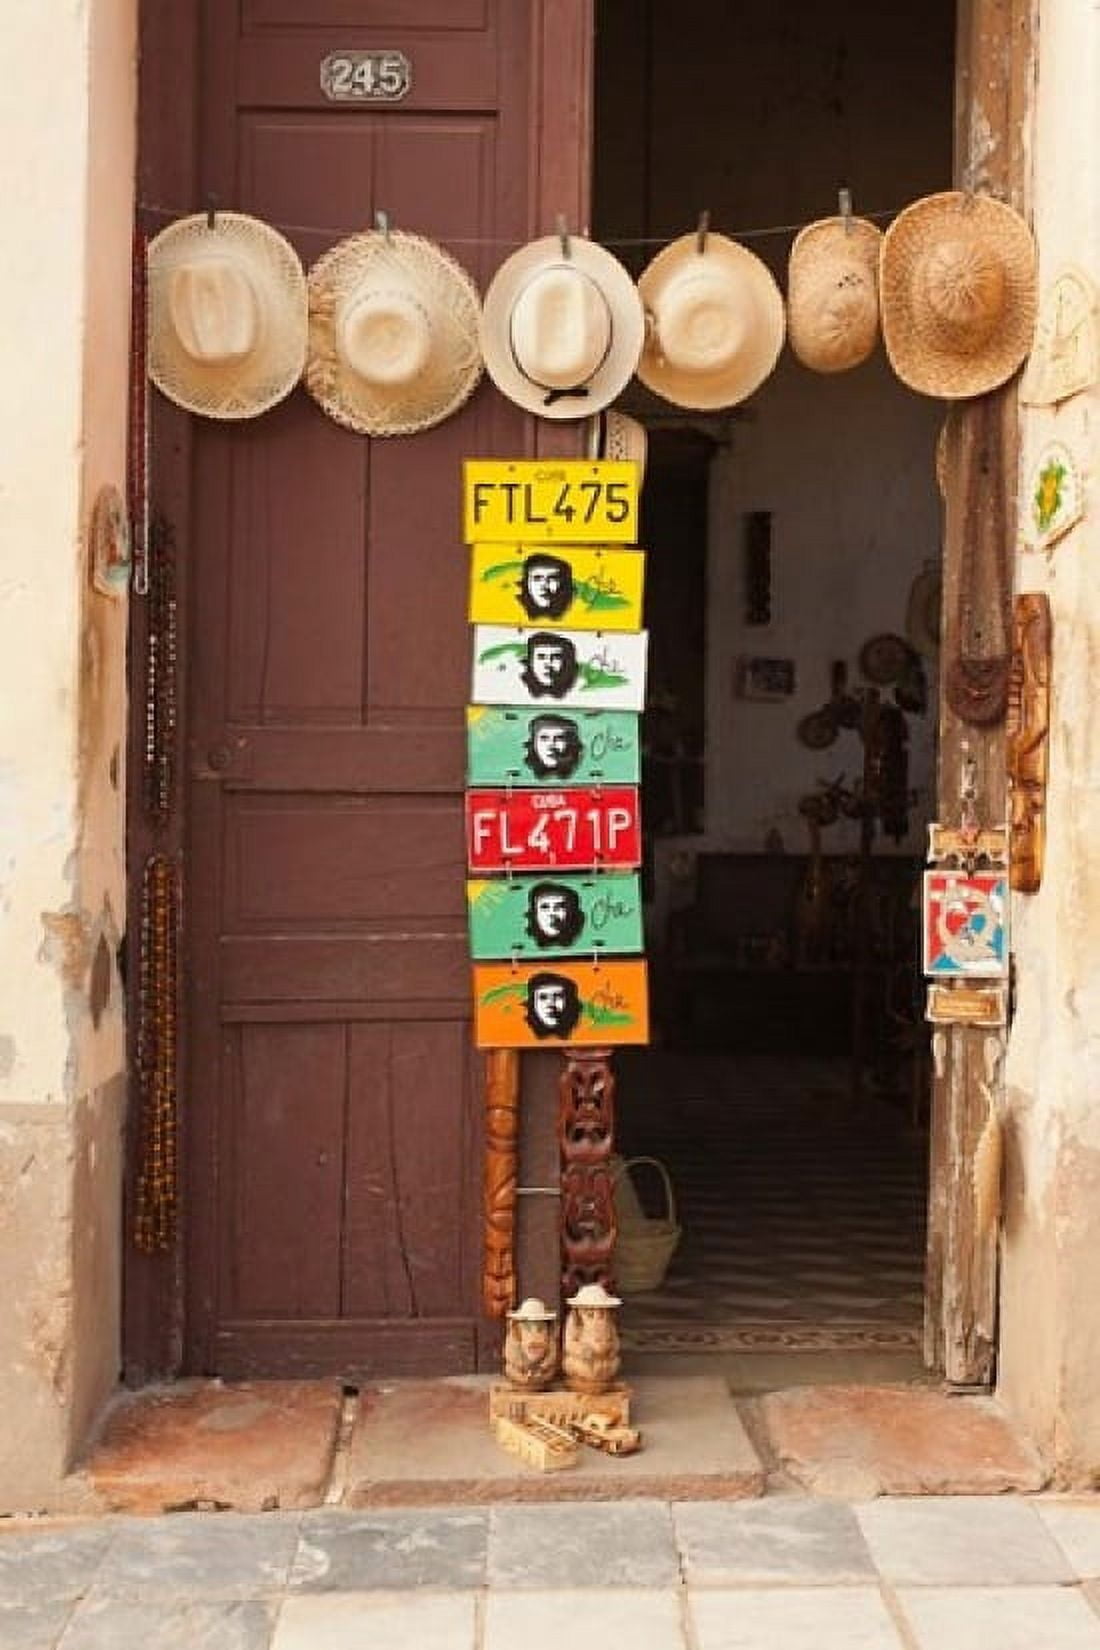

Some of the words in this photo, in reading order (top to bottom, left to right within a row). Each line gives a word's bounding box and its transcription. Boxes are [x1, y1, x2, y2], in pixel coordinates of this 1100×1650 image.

[332, 59, 401, 93] 245
[472, 483, 630, 524] FTL475
[472, 804, 631, 855] FL471P
